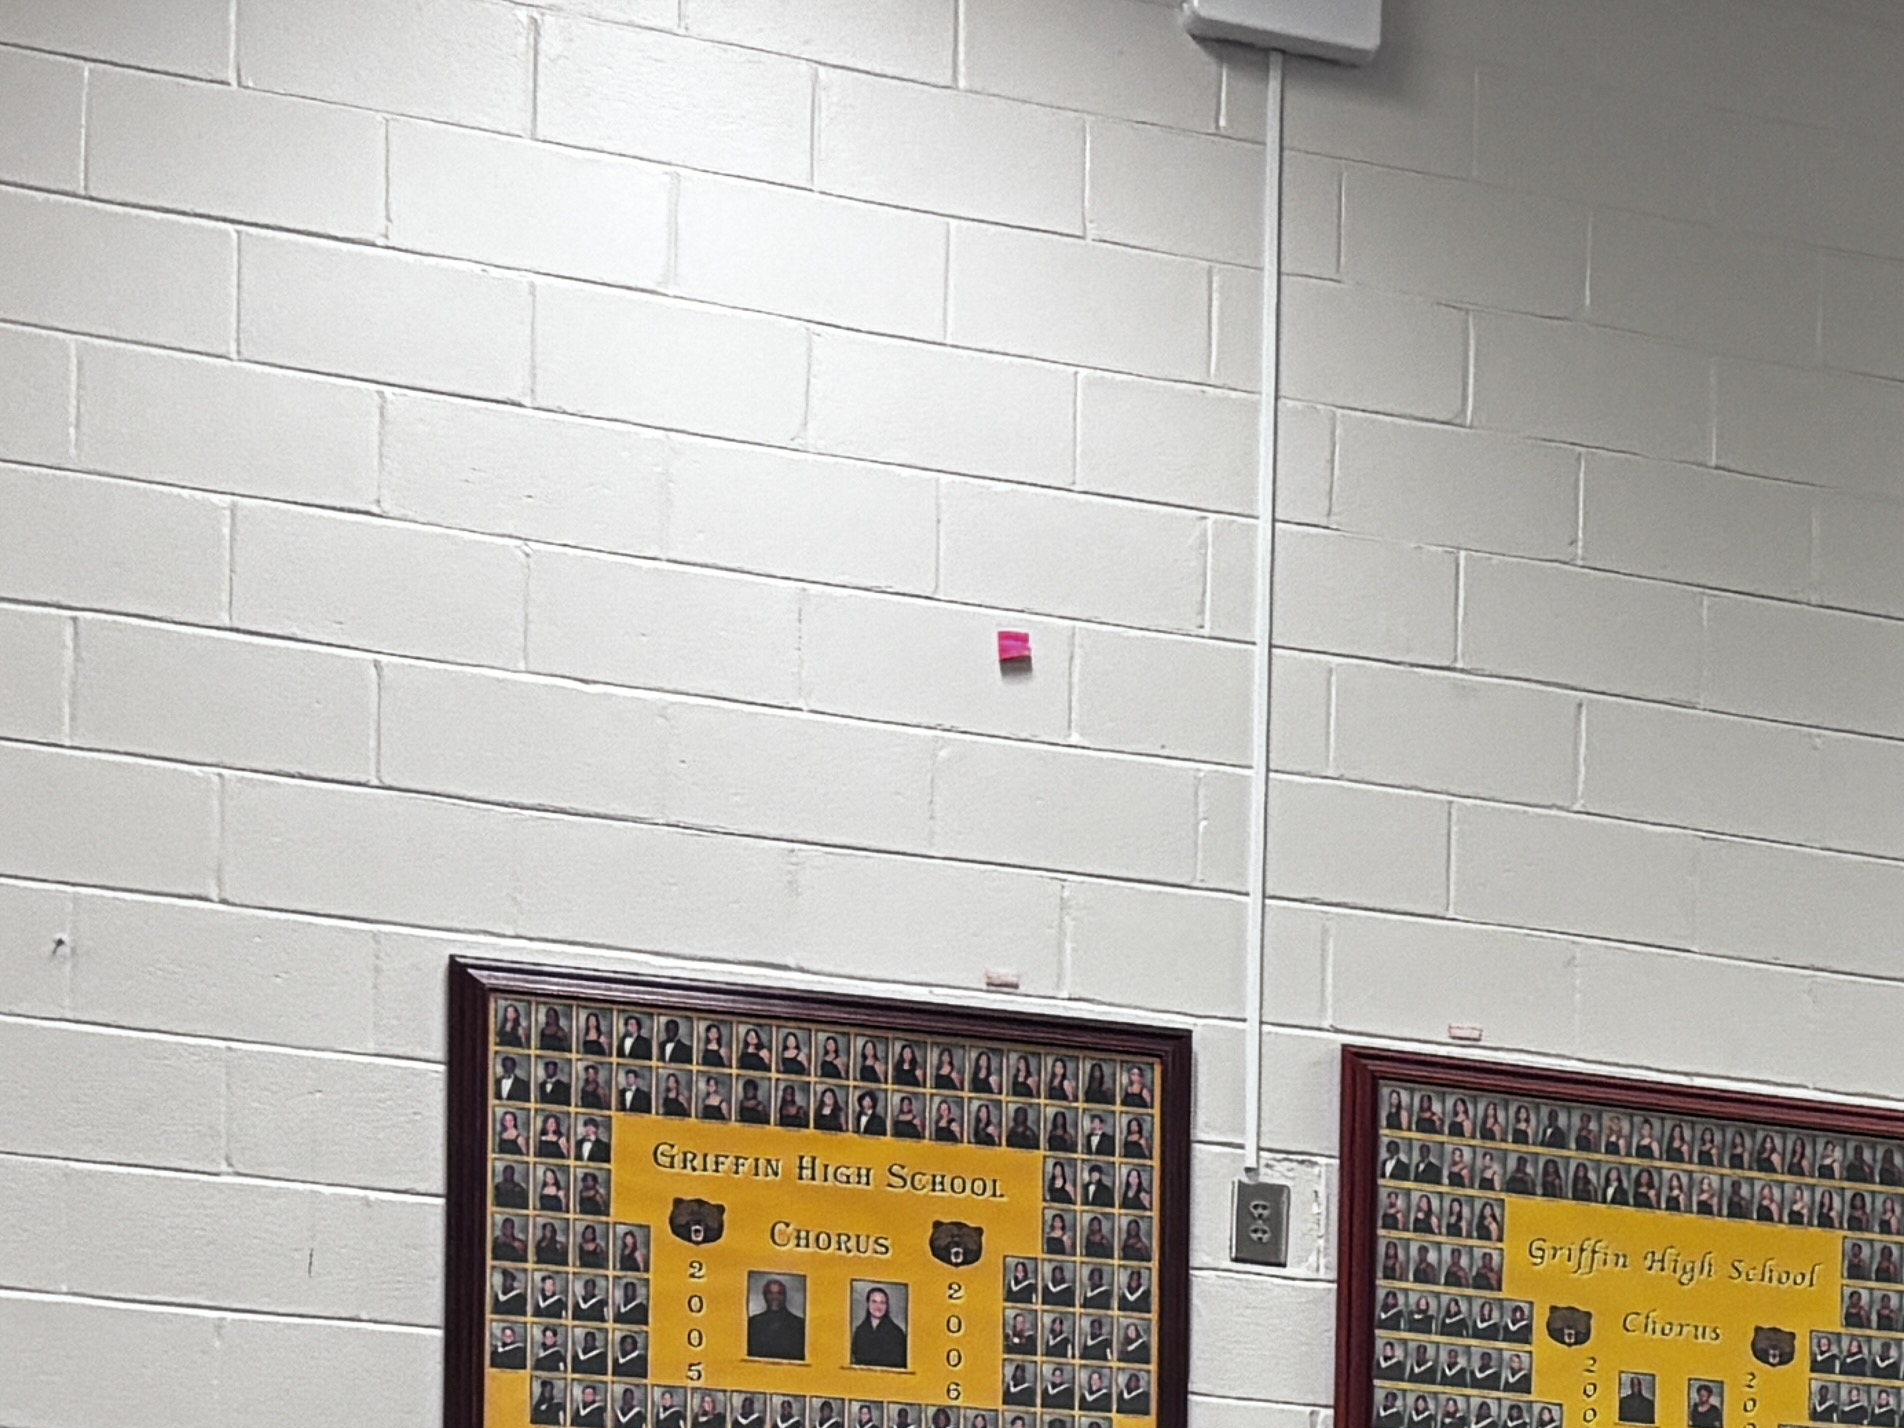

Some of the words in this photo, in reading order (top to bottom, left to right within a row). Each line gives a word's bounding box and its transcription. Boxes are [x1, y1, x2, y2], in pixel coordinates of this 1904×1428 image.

[652, 1142, 781, 1179] GRIFFIN
[796, 1155, 873, 1187] HIGH
[885, 1164, 1006, 1199] SCHOOL
[769, 1221, 891, 1256] CHORUS
[1528, 1237, 1629, 1277] Griffin
[1646, 1245, 1715, 1286] High
[1728, 1258, 1824, 1288] School
[1622, 1309, 1722, 1342] Chorus
